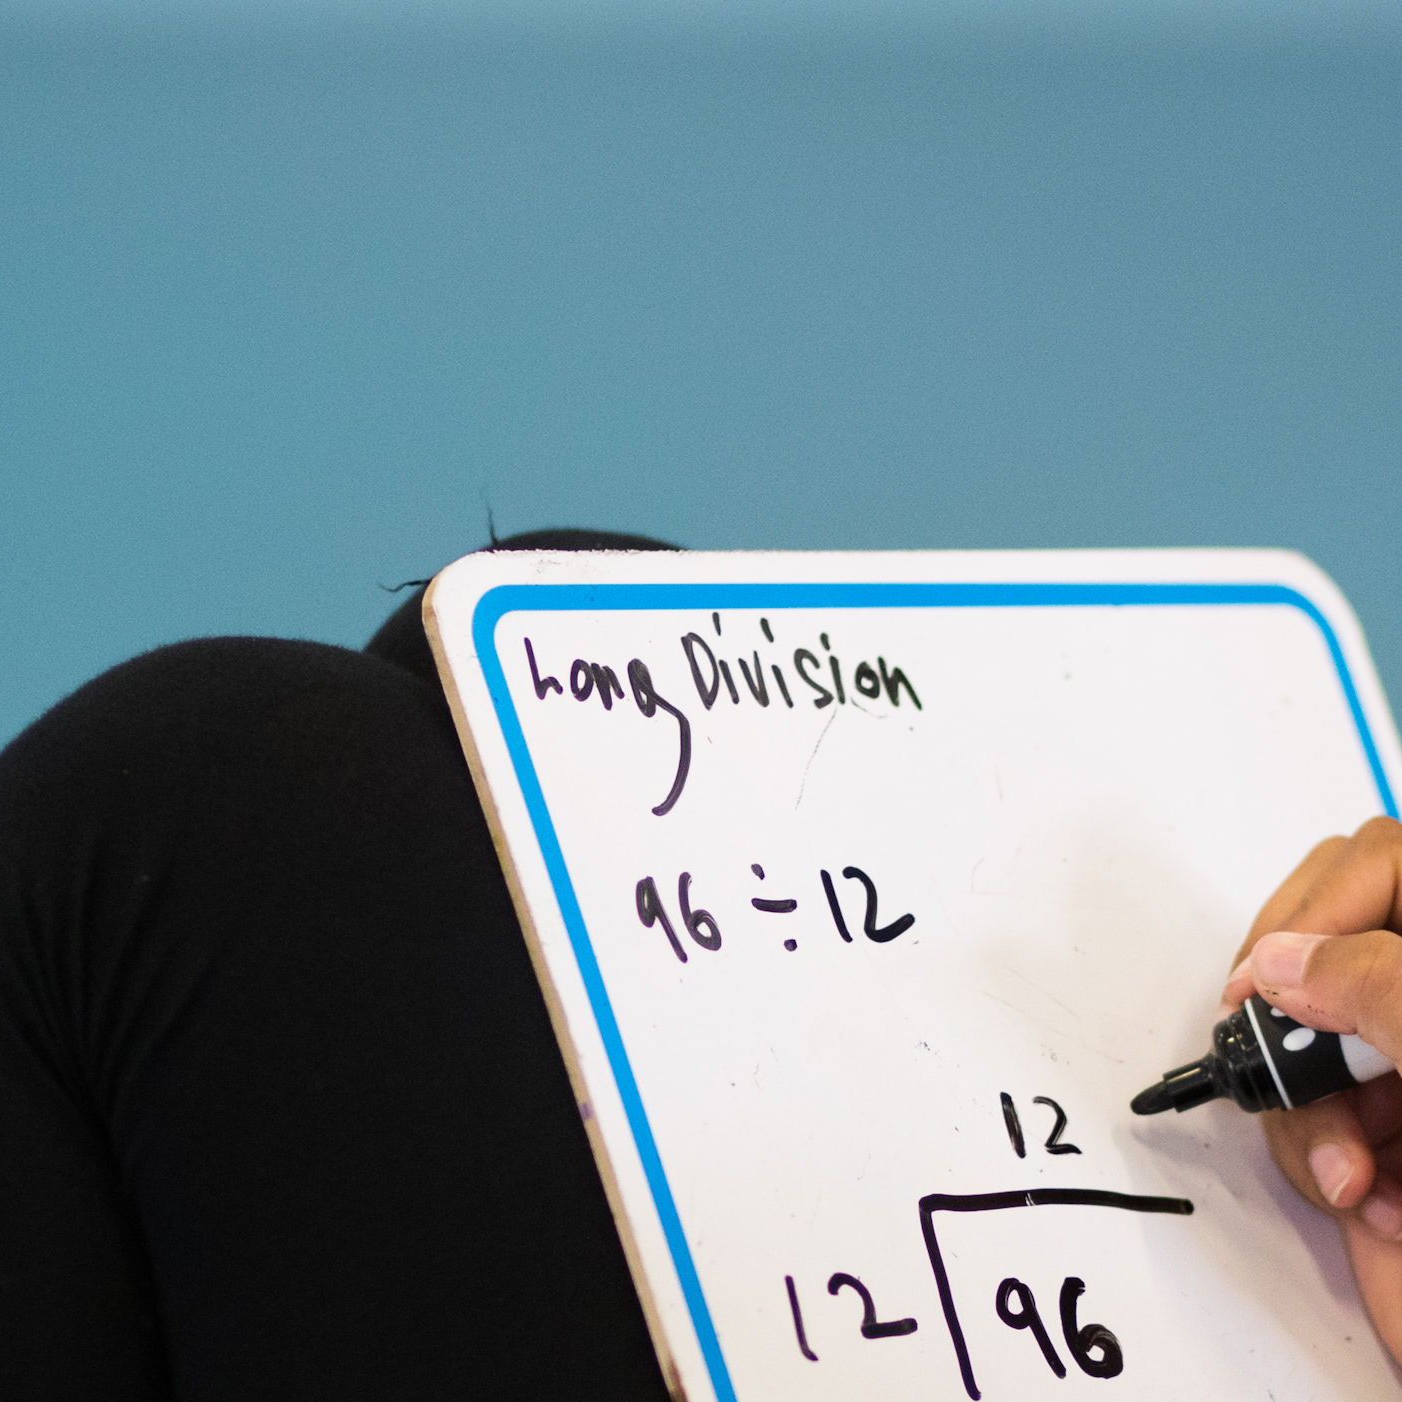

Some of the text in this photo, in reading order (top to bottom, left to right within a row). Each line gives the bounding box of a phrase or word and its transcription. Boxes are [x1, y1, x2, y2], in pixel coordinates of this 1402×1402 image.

[522, 610, 924, 817] Long Division
[634, 870, 723, 964] 96
[818, 865, 917, 944] 12
[999, 1090, 1084, 1160] 12
[784, 1271, 1126, 1381] 12 96
